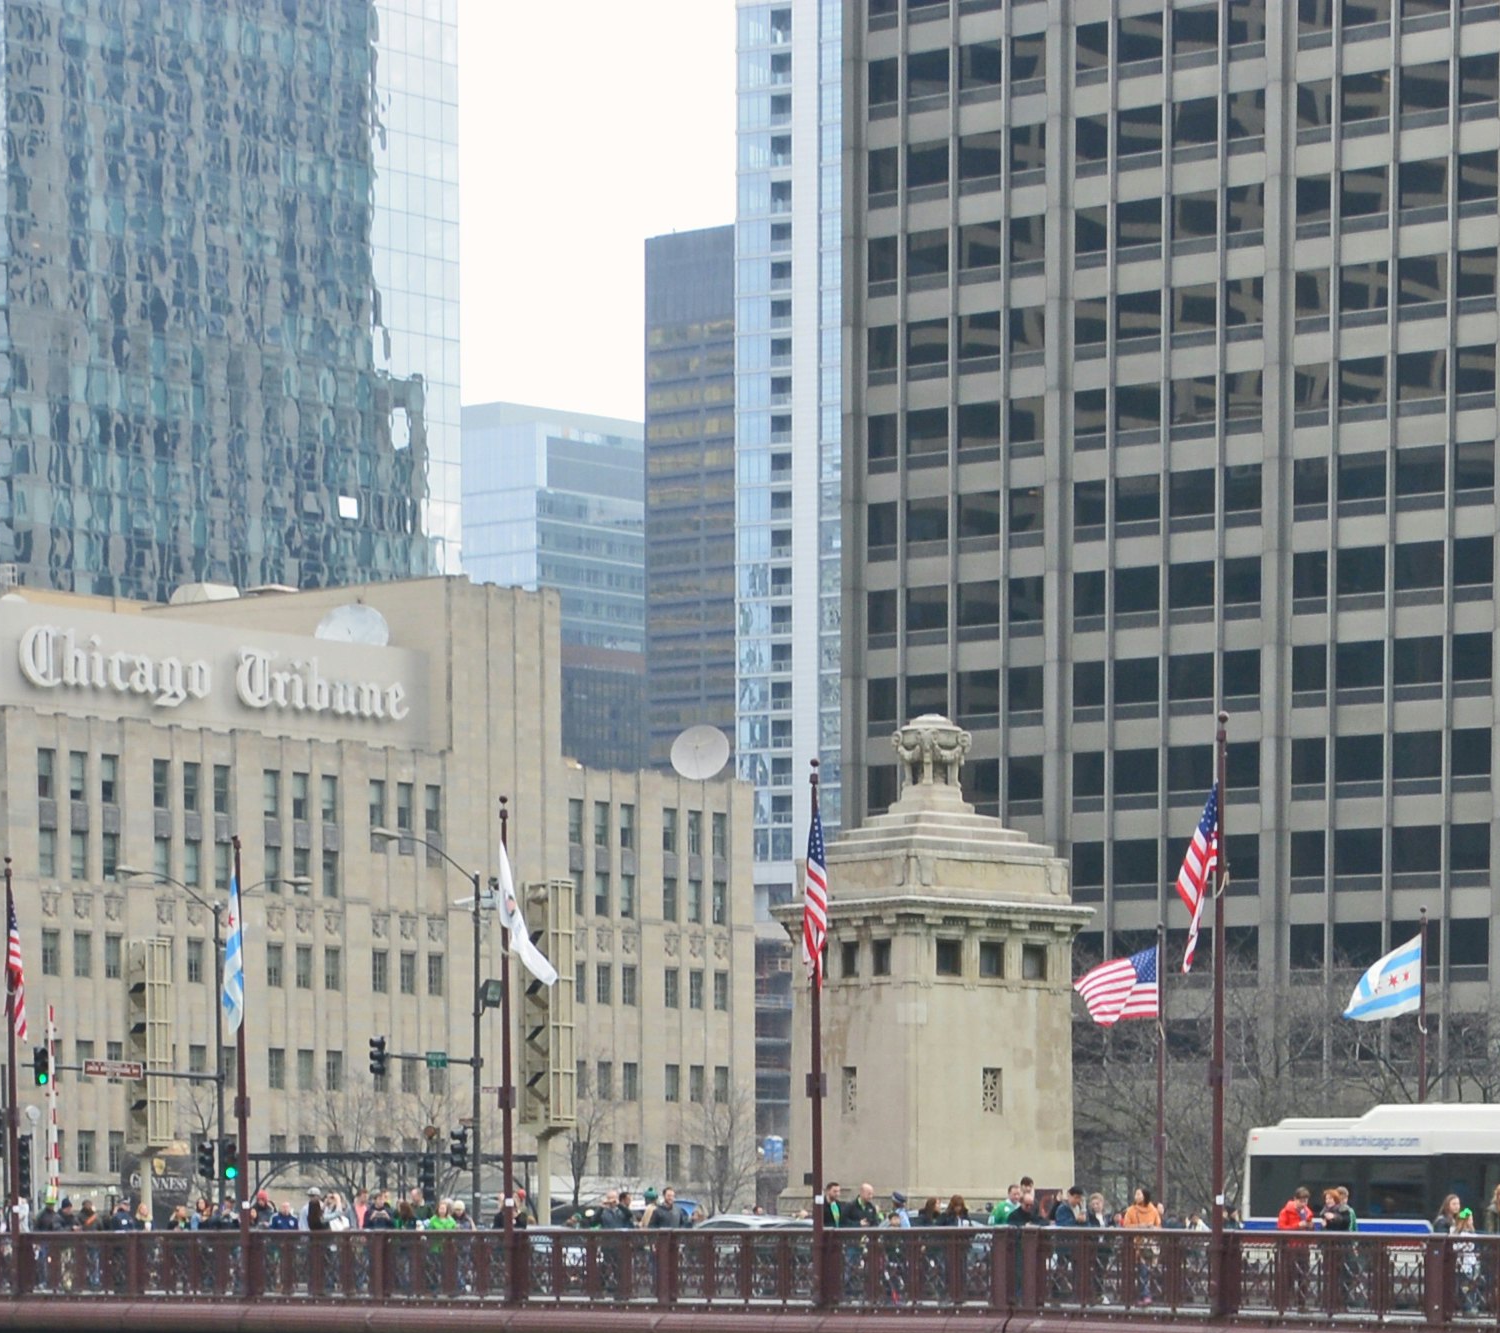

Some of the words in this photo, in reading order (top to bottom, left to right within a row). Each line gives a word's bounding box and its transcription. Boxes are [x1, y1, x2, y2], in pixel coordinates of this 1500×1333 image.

[18, 624, 212, 707] Chicago
[235, 645, 410, 721] Tribune
[1298, 1136, 1420, 1151] www.transitchicago.com
[129, 1172, 189, 1191] GNNESS
